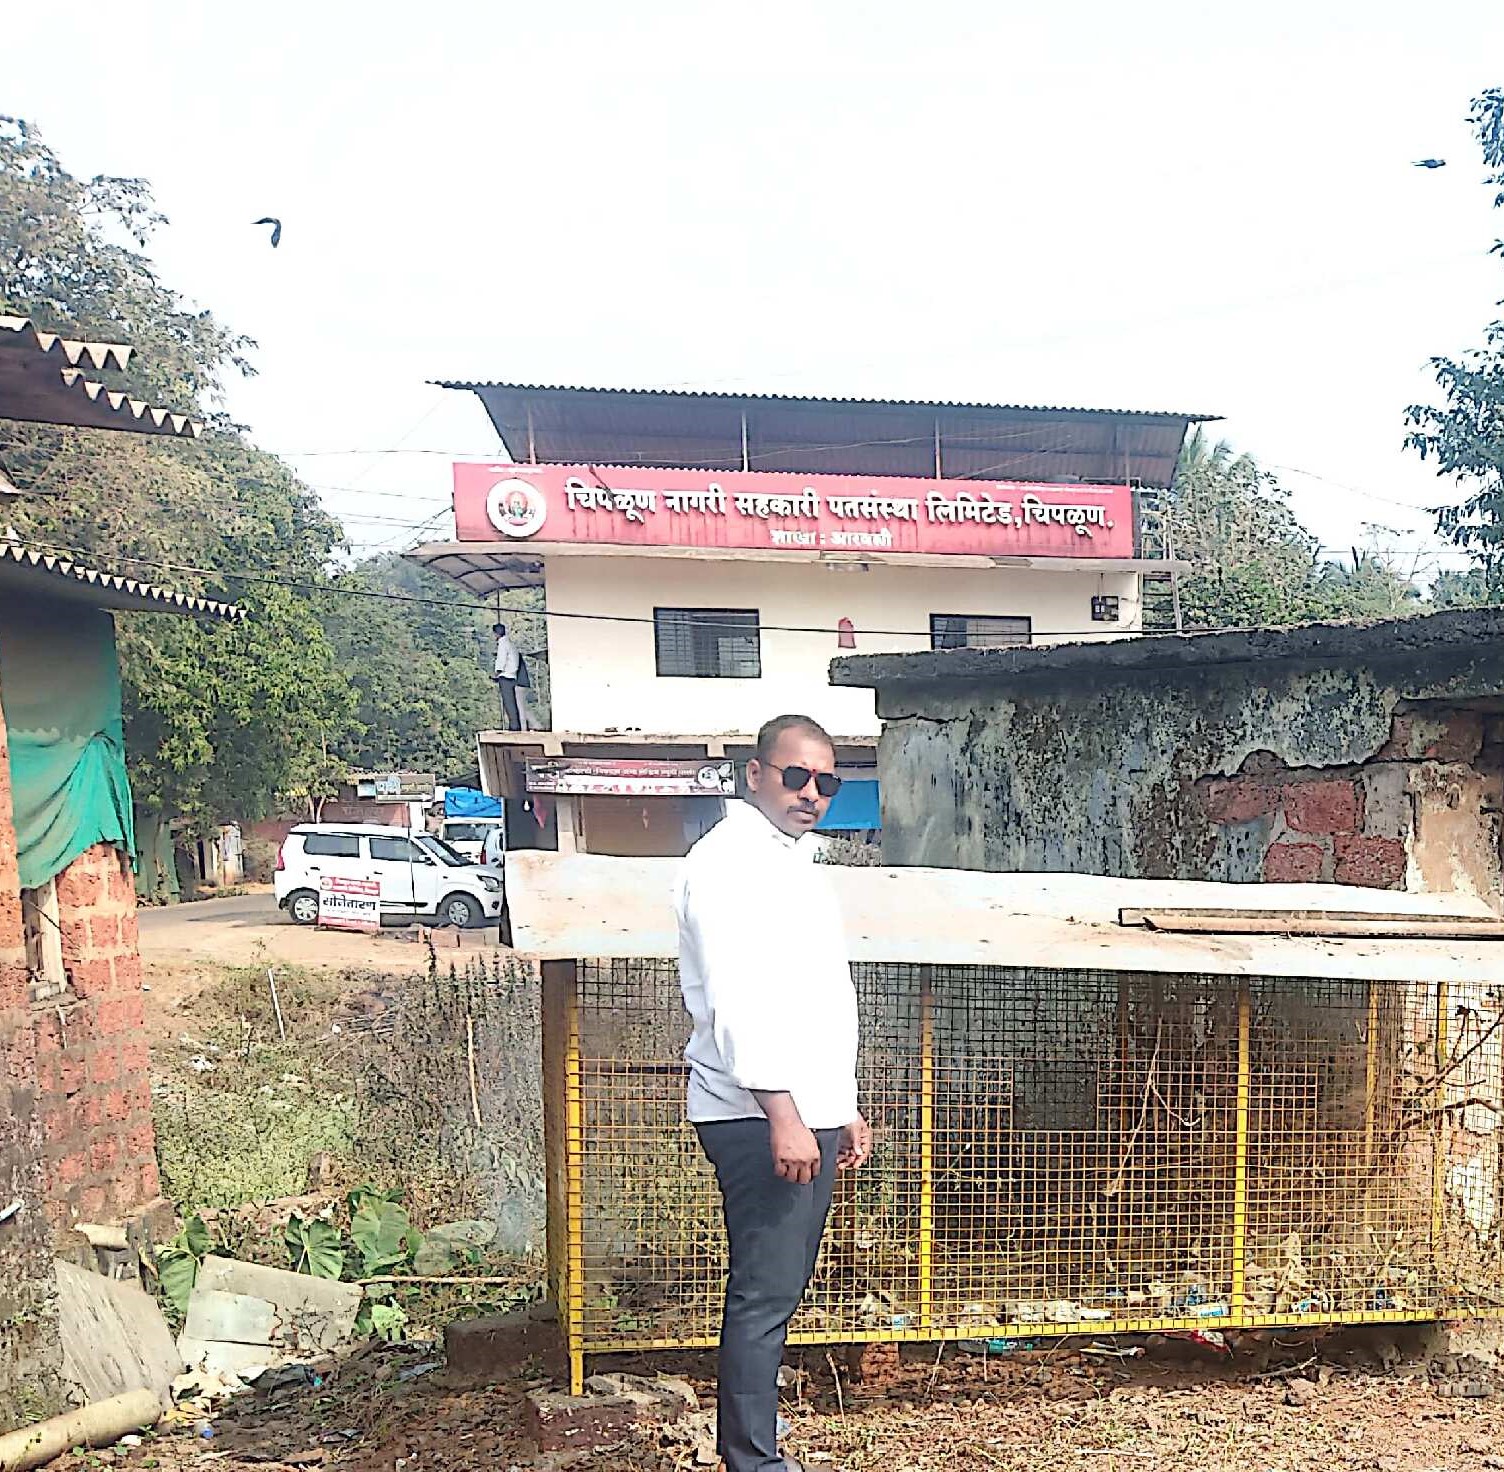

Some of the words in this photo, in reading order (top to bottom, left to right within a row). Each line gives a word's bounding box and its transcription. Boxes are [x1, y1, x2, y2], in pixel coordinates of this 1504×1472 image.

[662, 483, 727, 515] नागरी
[734, 486, 820, 519] सहकारी
[826, 488, 919, 522] पतसंस्था
